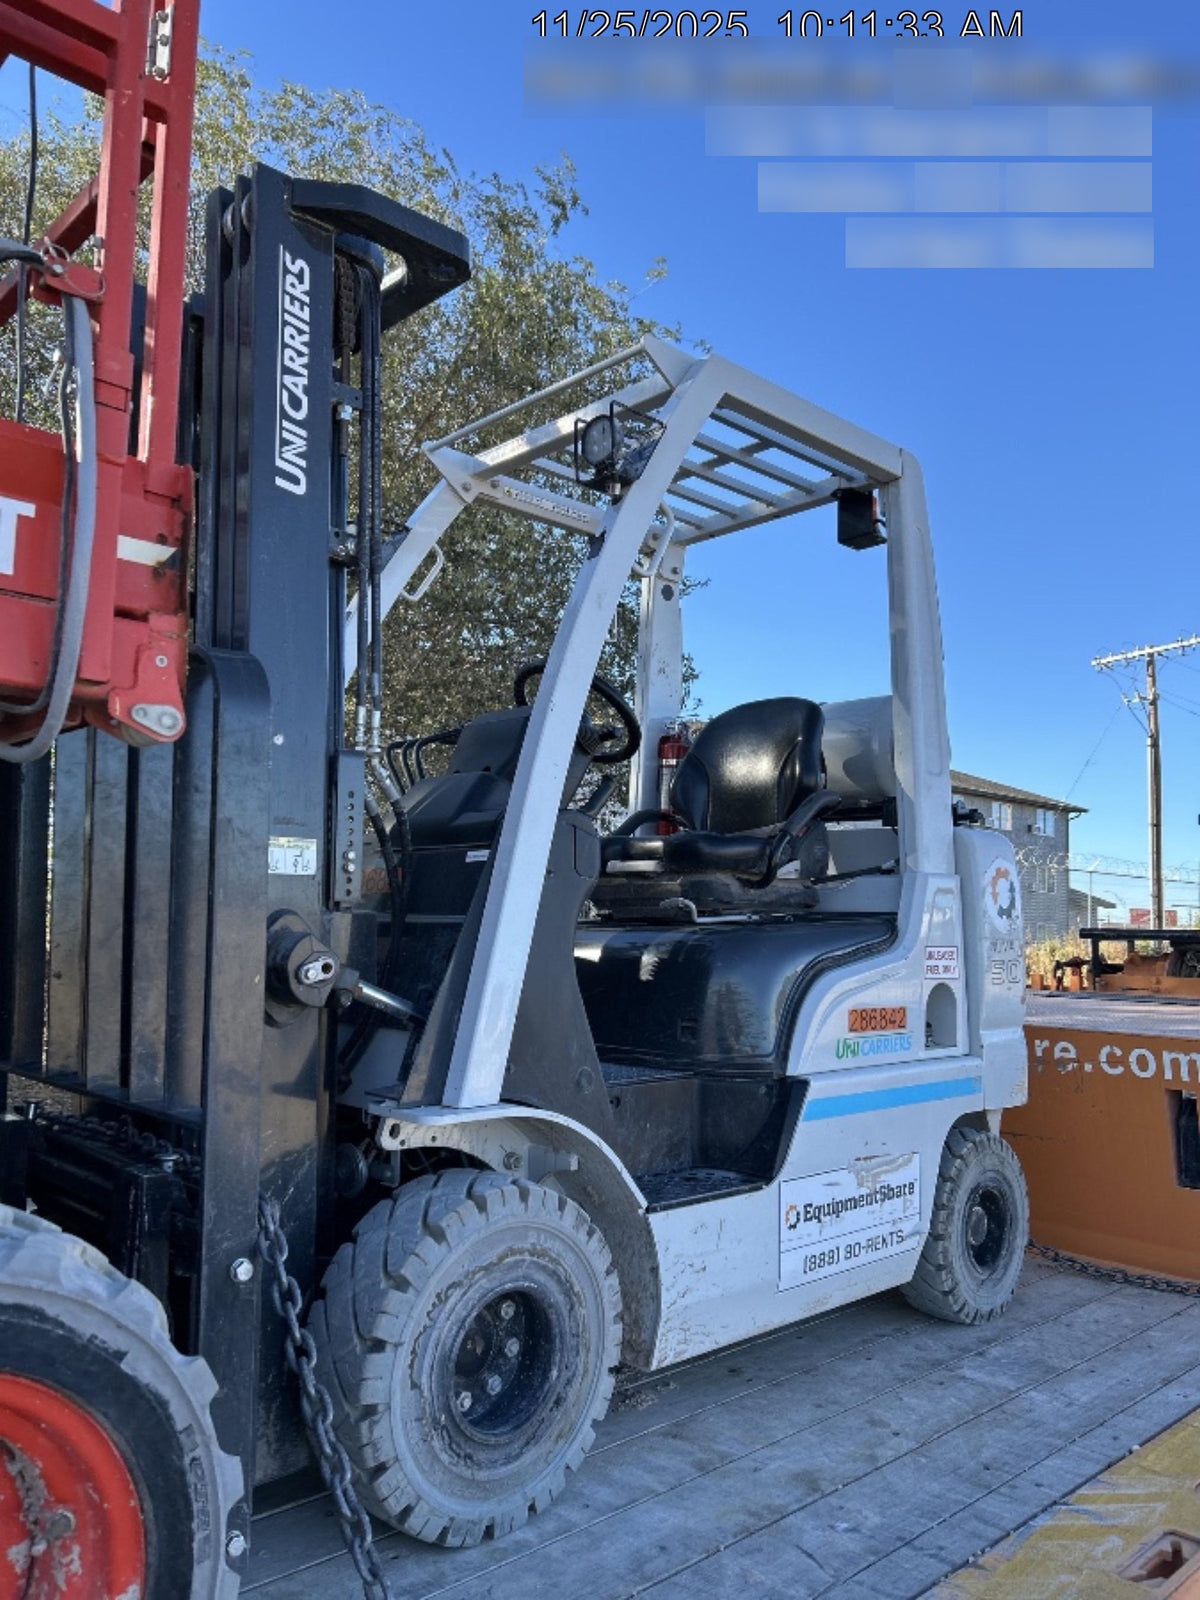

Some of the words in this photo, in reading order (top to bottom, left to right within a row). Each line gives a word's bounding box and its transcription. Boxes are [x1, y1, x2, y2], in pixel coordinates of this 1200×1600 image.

[275, 250, 310, 496] UNICARRIERS
[926, 964, 941, 975] FUEL
[942, 964, 957, 975] ONLY
[850, 1006, 907, 1032] 286842
[836, 1035, 912, 1060] UNICARRIERS
[803, 1180, 915, 1224] EquipmentShare
[803, 1246, 840, 1275] (888)
